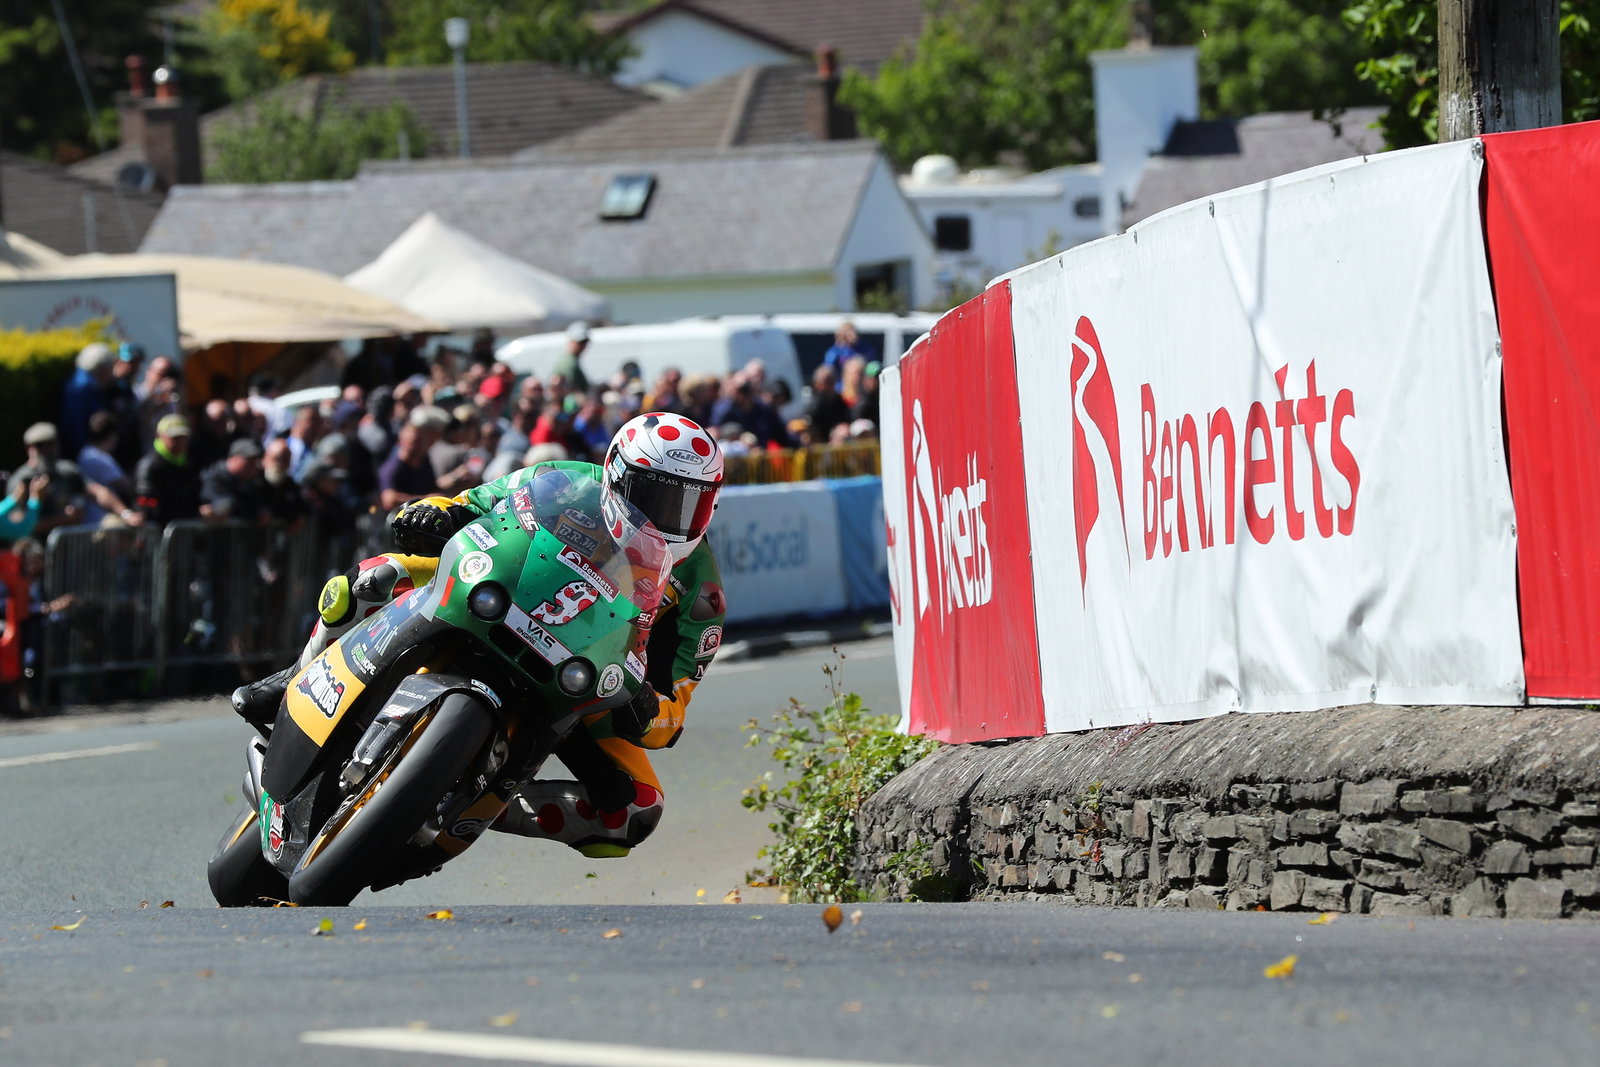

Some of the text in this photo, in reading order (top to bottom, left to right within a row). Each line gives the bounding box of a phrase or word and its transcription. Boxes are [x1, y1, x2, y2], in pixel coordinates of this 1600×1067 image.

[671, 450, 701, 464] HJC
[1141, 359, 1361, 560] Bennetts
[582, 562, 615, 596] Bennetts
[530, 580, 599, 626] 9
[527, 620, 556, 650] VAS
